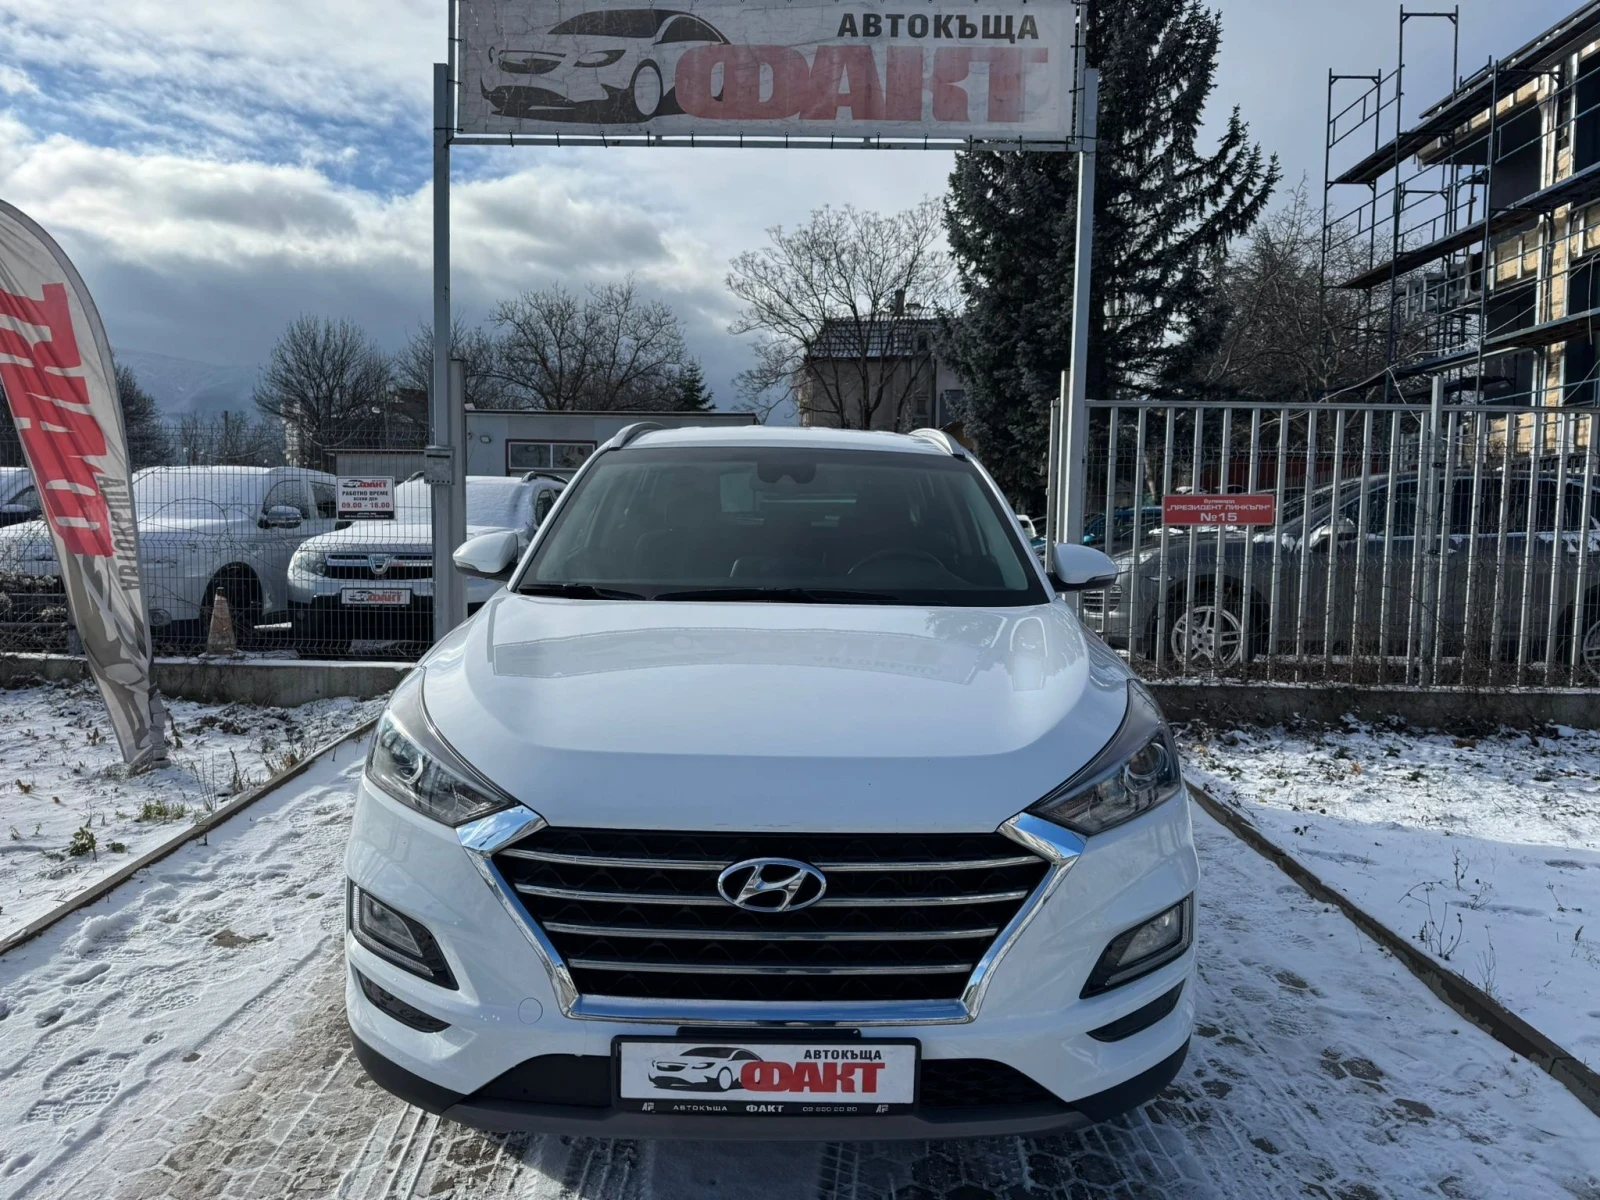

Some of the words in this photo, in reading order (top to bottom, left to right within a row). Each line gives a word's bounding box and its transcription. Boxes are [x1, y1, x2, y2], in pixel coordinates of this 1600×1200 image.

[837, 13, 1039, 44] АВТОКЪЩА
[674, 44, 1049, 123] ФАКТ
[1200, 512, 1238, 522] №15
[803, 1049, 882, 1062] АВТОКЪЩА
[740, 1061, 886, 1093] ФАКТ
[745, 1104, 785, 1113] ФАКТ
